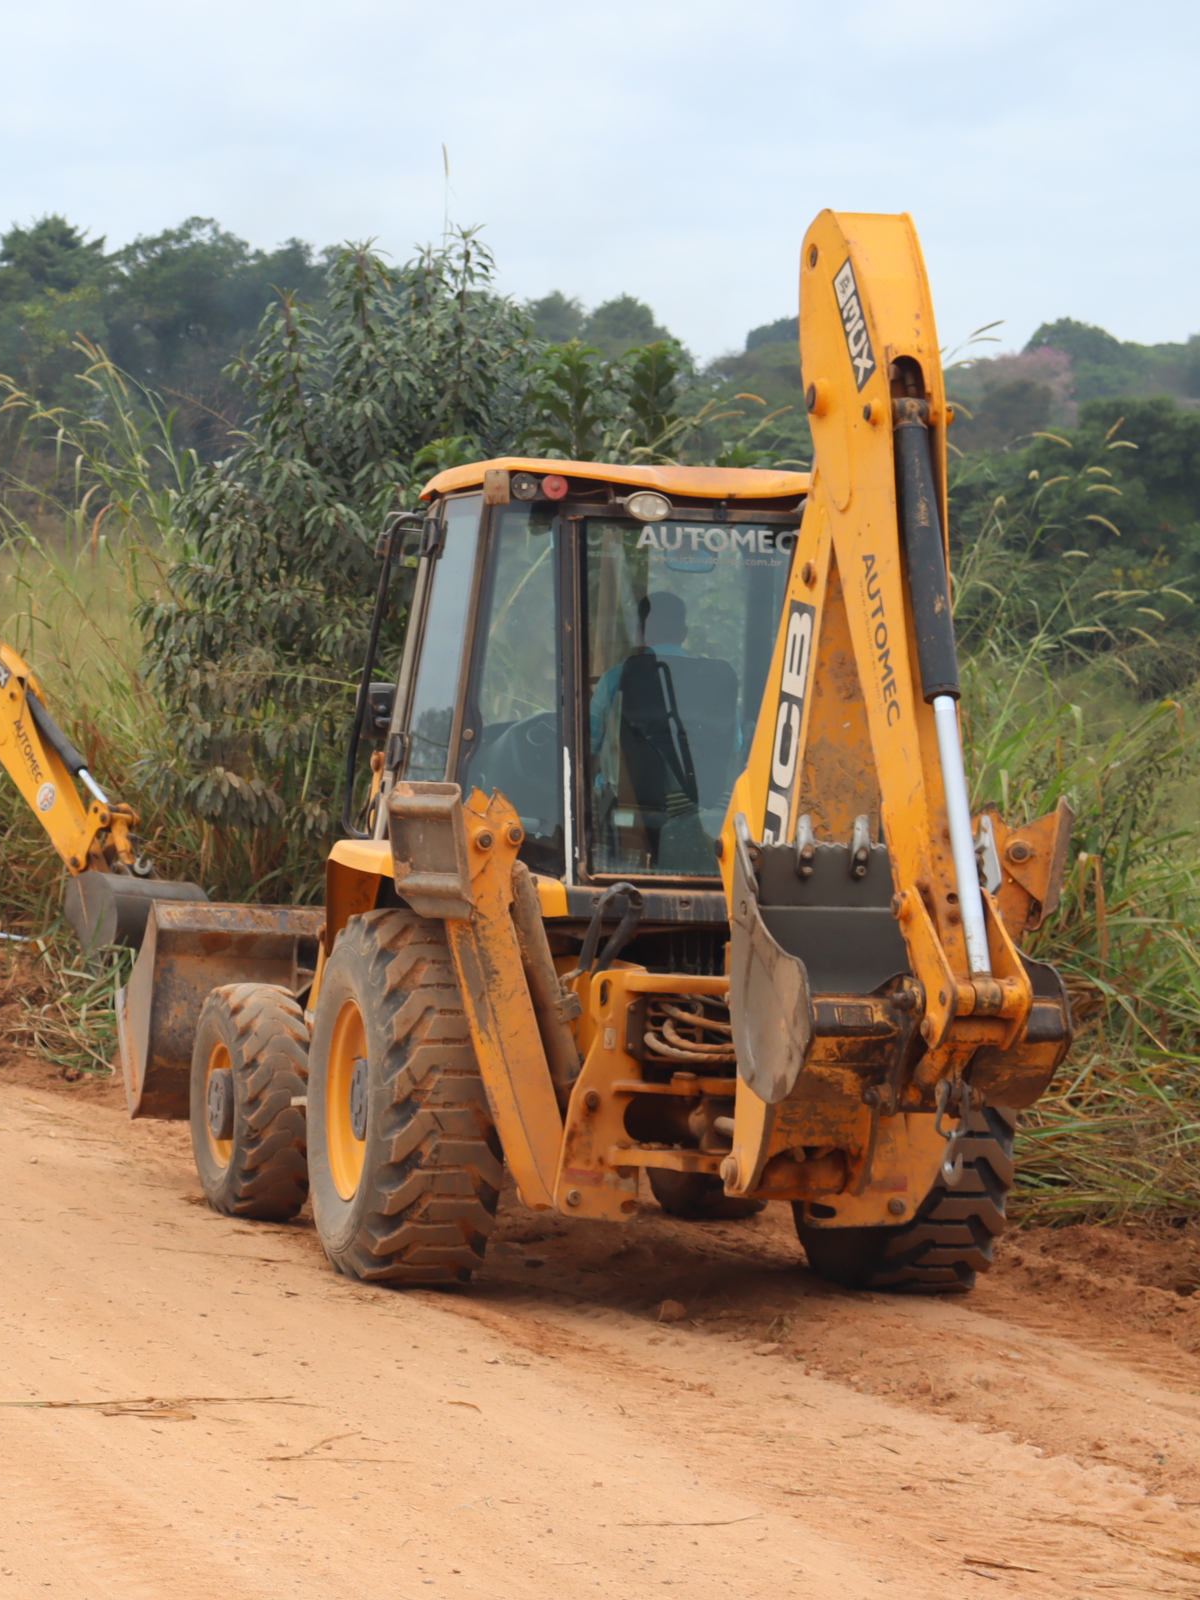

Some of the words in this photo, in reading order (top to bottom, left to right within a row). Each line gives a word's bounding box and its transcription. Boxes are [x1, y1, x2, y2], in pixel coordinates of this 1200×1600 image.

[636, 525, 793, 555] AUTOMEC
[862, 554, 900, 727] AUTOMEC
[13, 719, 43, 784] AUTOMEC
[765, 611, 812, 845] JCB
